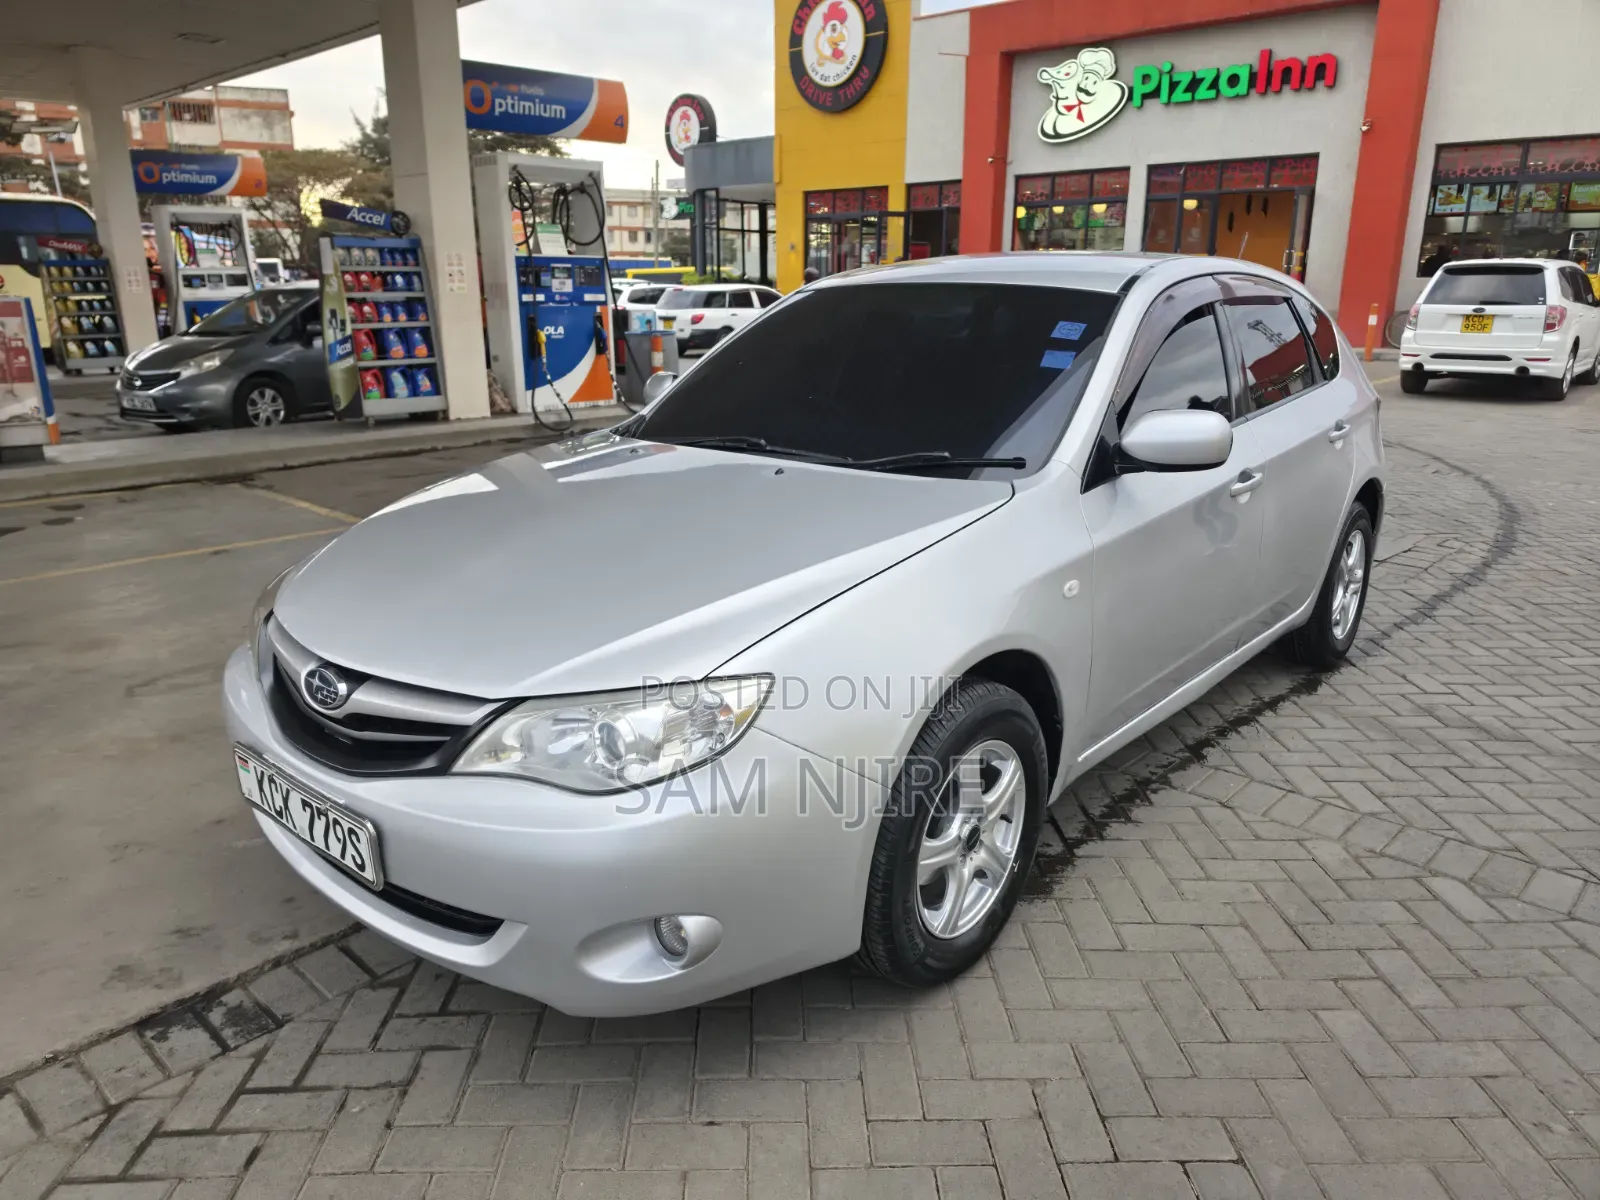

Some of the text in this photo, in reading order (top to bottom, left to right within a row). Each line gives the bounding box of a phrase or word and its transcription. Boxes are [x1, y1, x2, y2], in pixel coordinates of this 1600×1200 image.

[800, 65, 871, 107] DRIVE THRU
[464, 79, 566, 119] Optimium
[614, 114, 625, 128] 4
[138, 161, 217, 184] Optimium
[346, 207, 387, 226] Accel
[1464, 323, 1490, 331] 950F
[1465, 314, 1485, 323] KCD
[544, 326, 564, 335] OLA
[253, 765, 366, 873] KCK 779S
